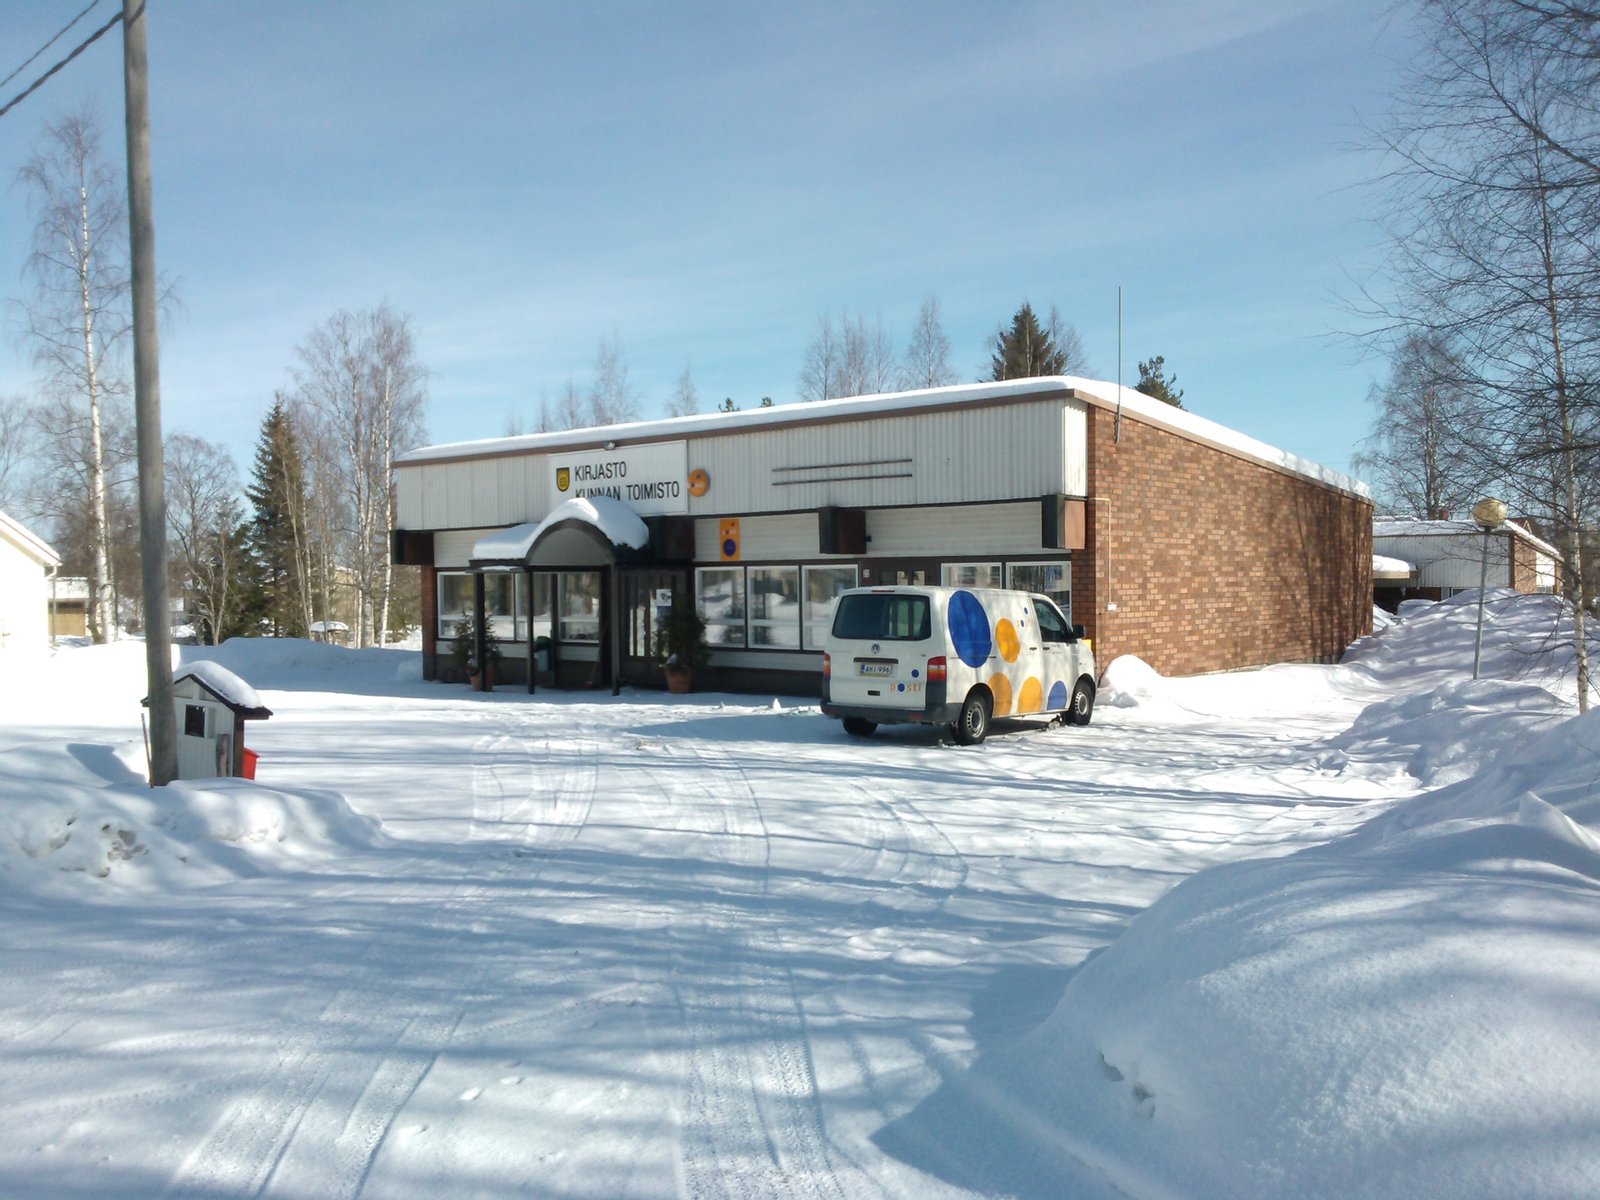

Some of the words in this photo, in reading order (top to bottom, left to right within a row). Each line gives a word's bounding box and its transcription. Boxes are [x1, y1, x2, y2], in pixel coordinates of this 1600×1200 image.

[574, 461, 627, 481] KIRJASTO
[575, 485, 621, 501] KUNNAN
[626, 481, 680, 501] TOIMISTO
